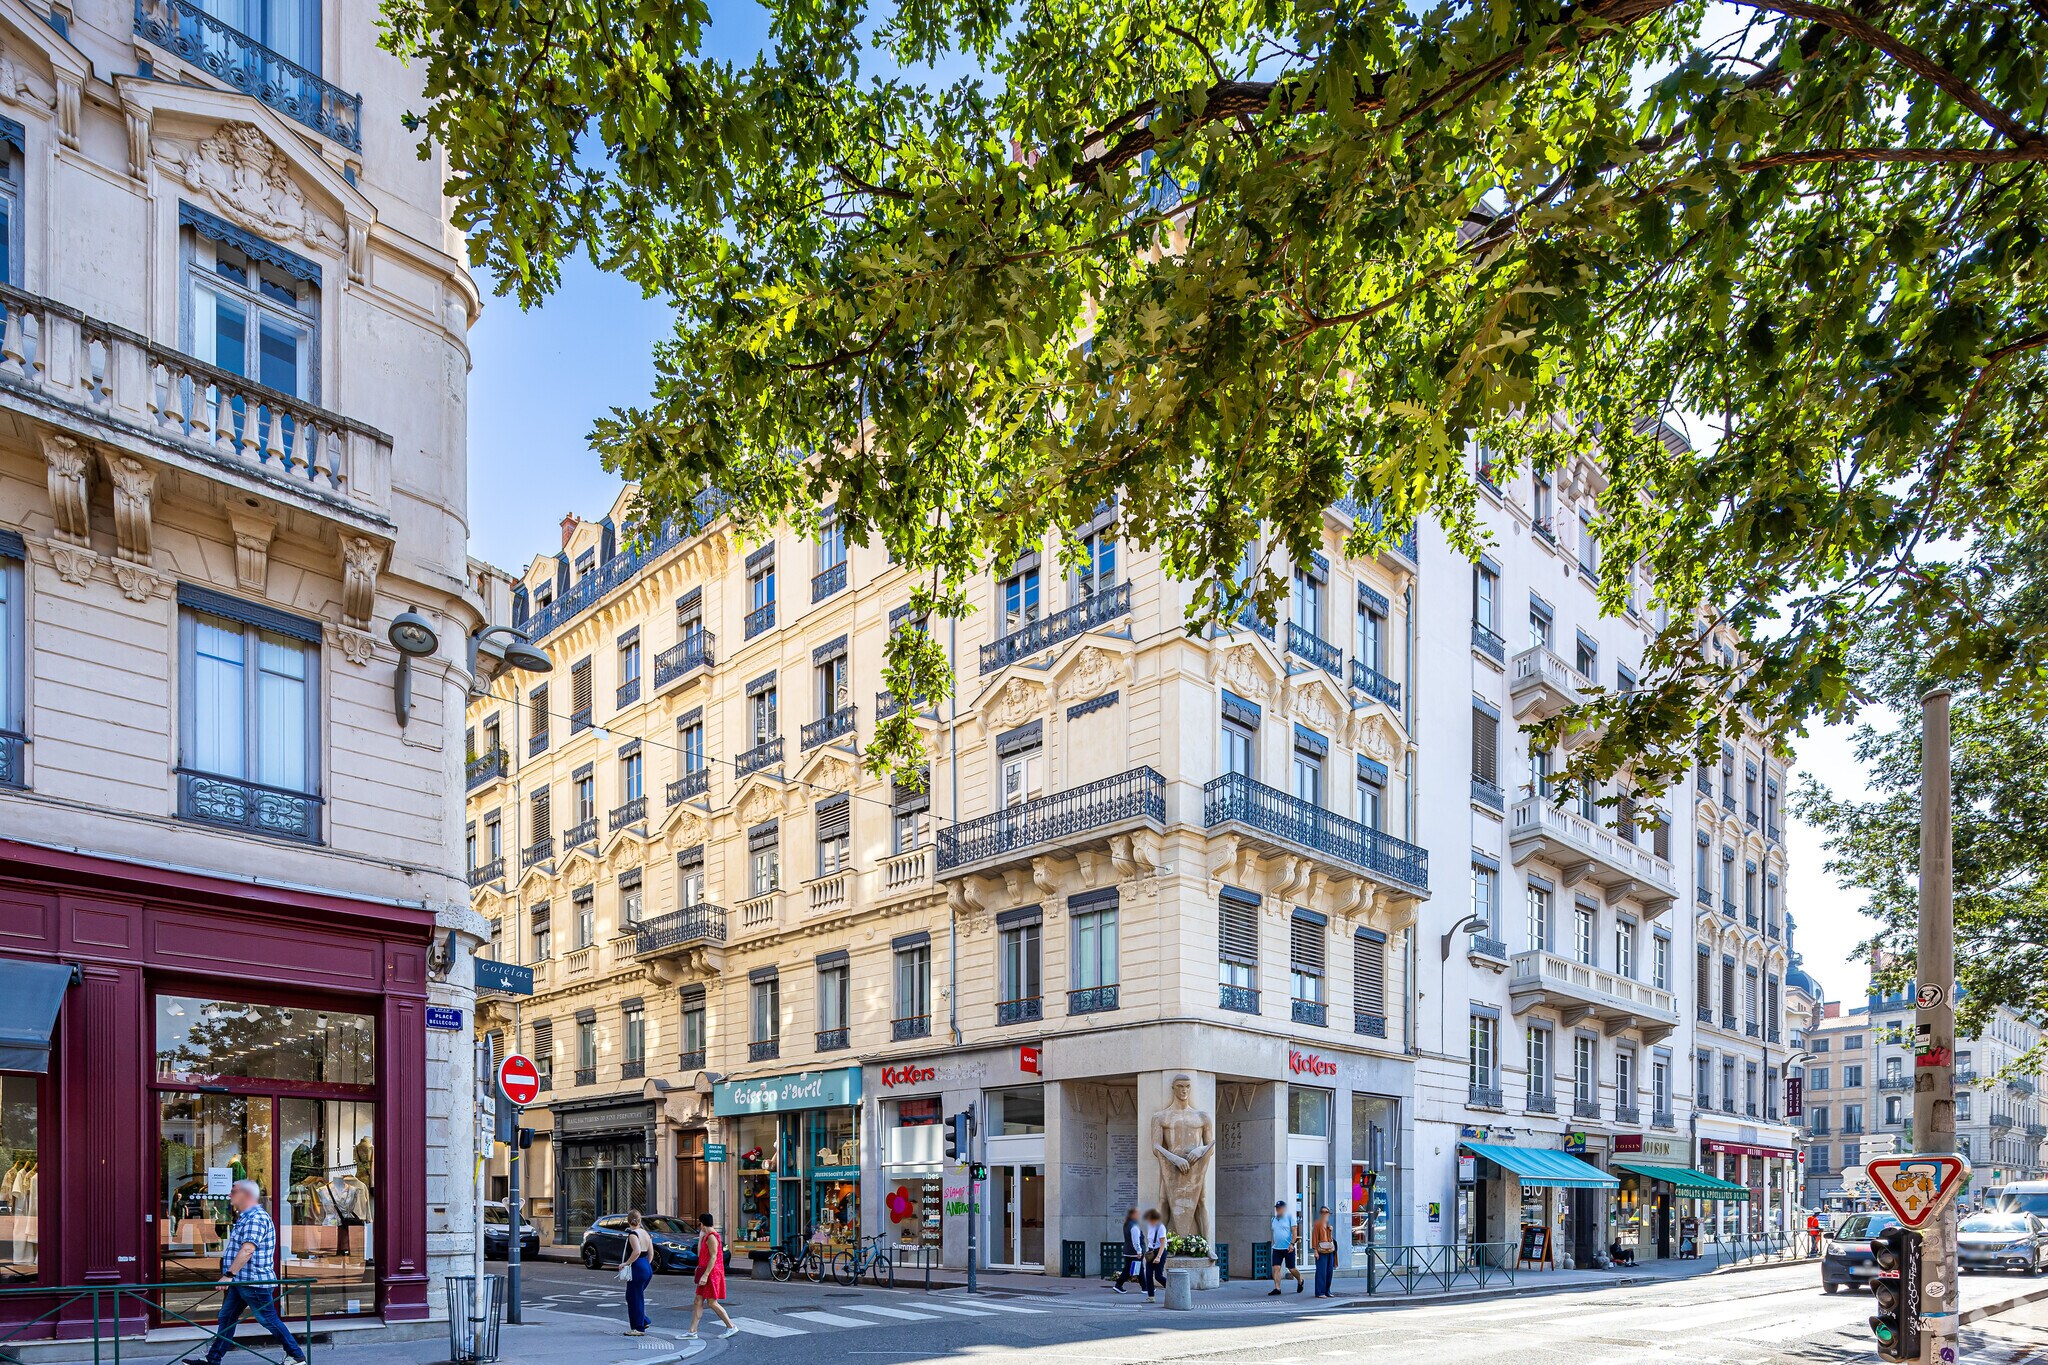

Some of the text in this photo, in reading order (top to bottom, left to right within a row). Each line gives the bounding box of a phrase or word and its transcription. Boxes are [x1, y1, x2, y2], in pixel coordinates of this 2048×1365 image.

[481, 962, 530, 979] Cotélac
[434, 1013, 454, 1021] PLACE
[429, 1019, 459, 1027] BELLECOUR
[734, 1089, 778, 1105] Poisson
[1643, 1141, 1670, 1155] OISIN
[921, 1184, 940, 1192] vibes
[921, 1196, 940, 1204] vibes
[921, 1208, 940, 1216] vibes
[921, 1231, 940, 1239] vibes
[892, 1242, 920, 1251] Summer
